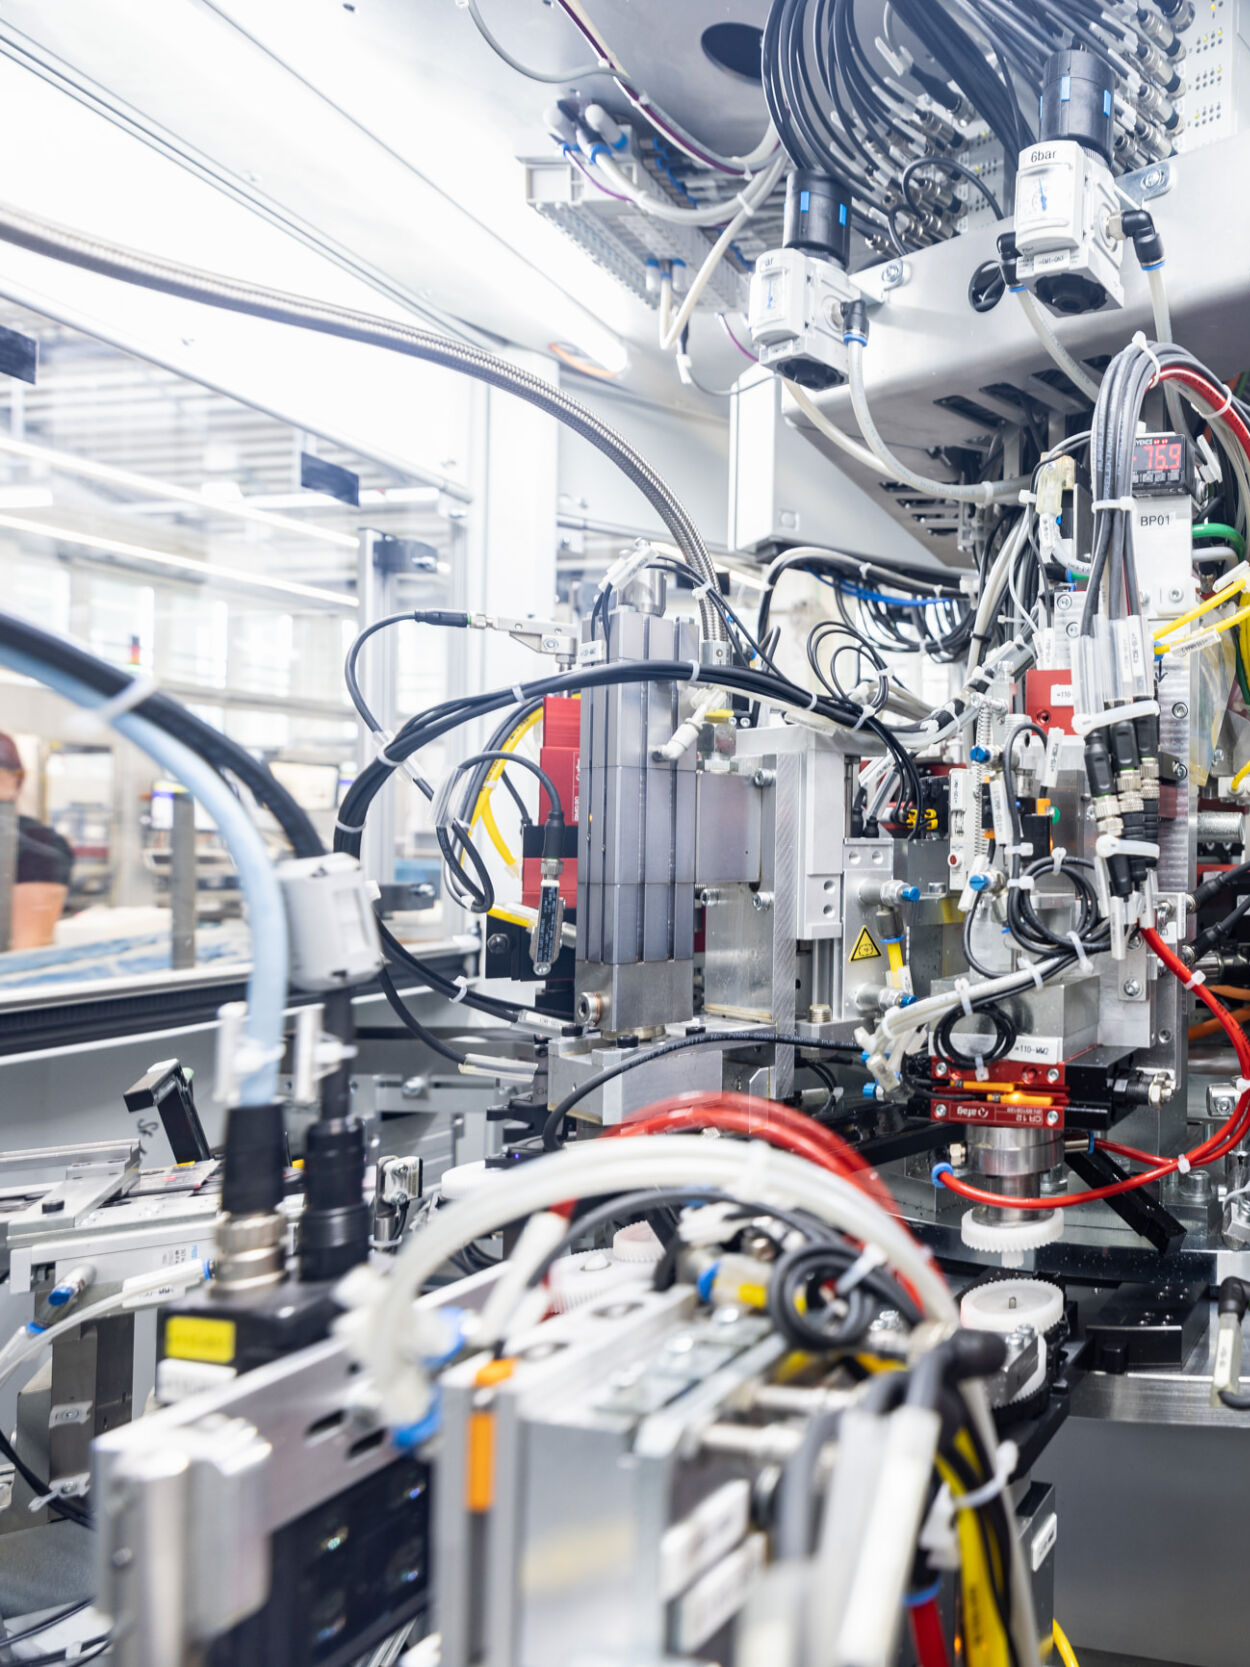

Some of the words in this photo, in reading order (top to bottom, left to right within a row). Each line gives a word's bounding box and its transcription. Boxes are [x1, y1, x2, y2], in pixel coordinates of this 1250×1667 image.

[1030, 150, 1057, 163] 6bar
[1139, 514, 1171, 527] BP01
[956, 1106, 977, 1116] afag
